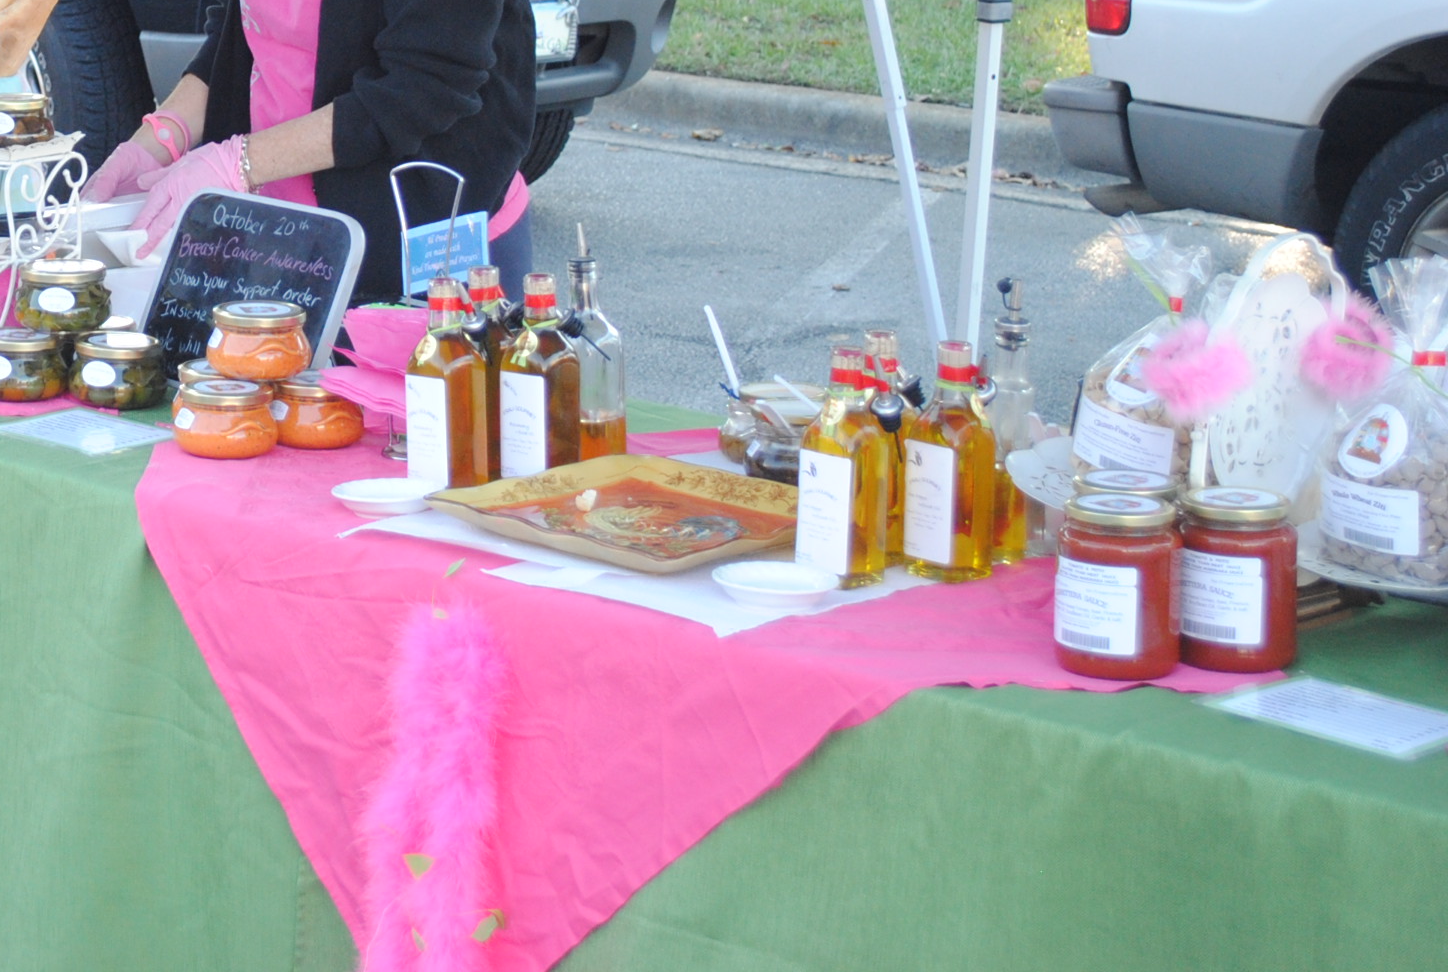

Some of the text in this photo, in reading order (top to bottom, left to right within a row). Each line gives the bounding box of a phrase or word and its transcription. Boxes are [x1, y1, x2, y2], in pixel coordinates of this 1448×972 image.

[213, 203, 264, 236] October
[178, 233, 334, 280] Breast Cancer Awareness
[169, 268, 322, 307] Show your Support order
